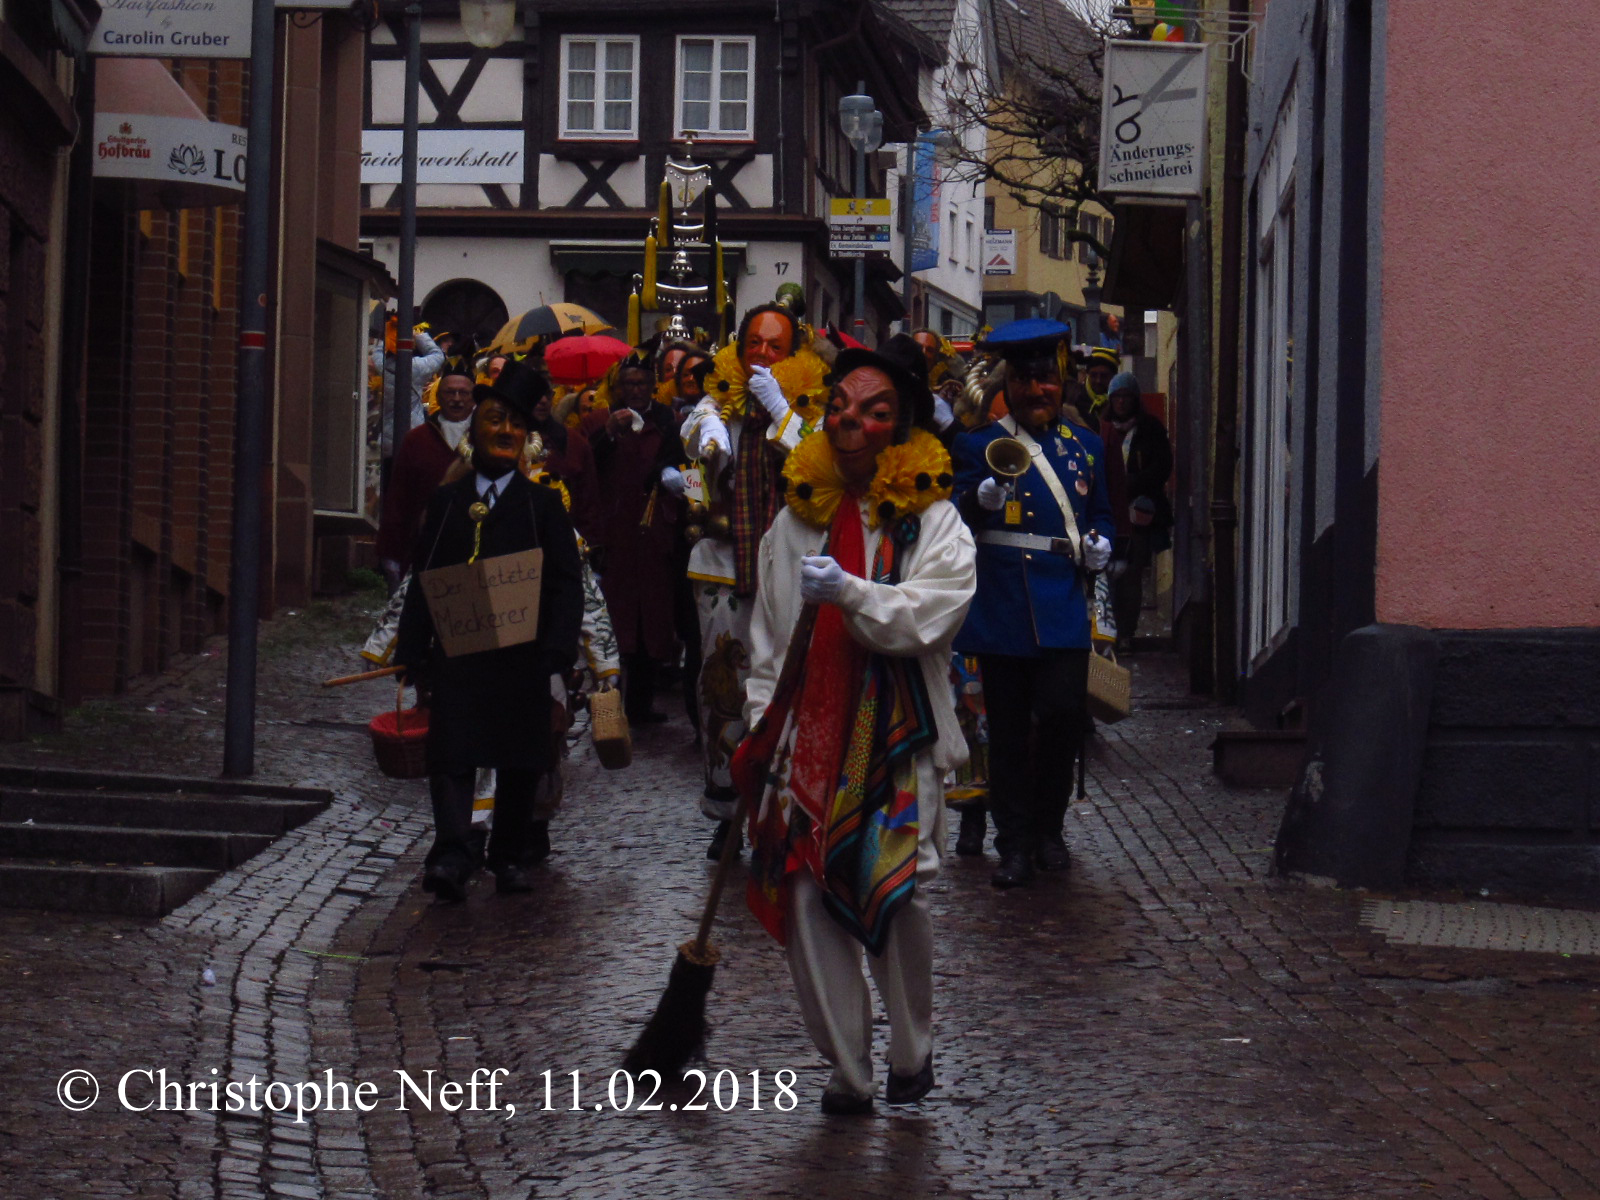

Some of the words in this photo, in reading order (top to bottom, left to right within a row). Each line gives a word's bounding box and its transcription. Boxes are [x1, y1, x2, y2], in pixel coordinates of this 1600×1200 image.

[103, 31, 164, 45] Carolin
[171, 32, 230, 46] Gruber
[98, 143, 150, 159] Hofbräu
[1109, 161, 1193, 183] schneiderei
[774, 262, 790, 275] 17
[428, 578, 462, 599] Der
[434, 602, 529, 639] Meckerer
